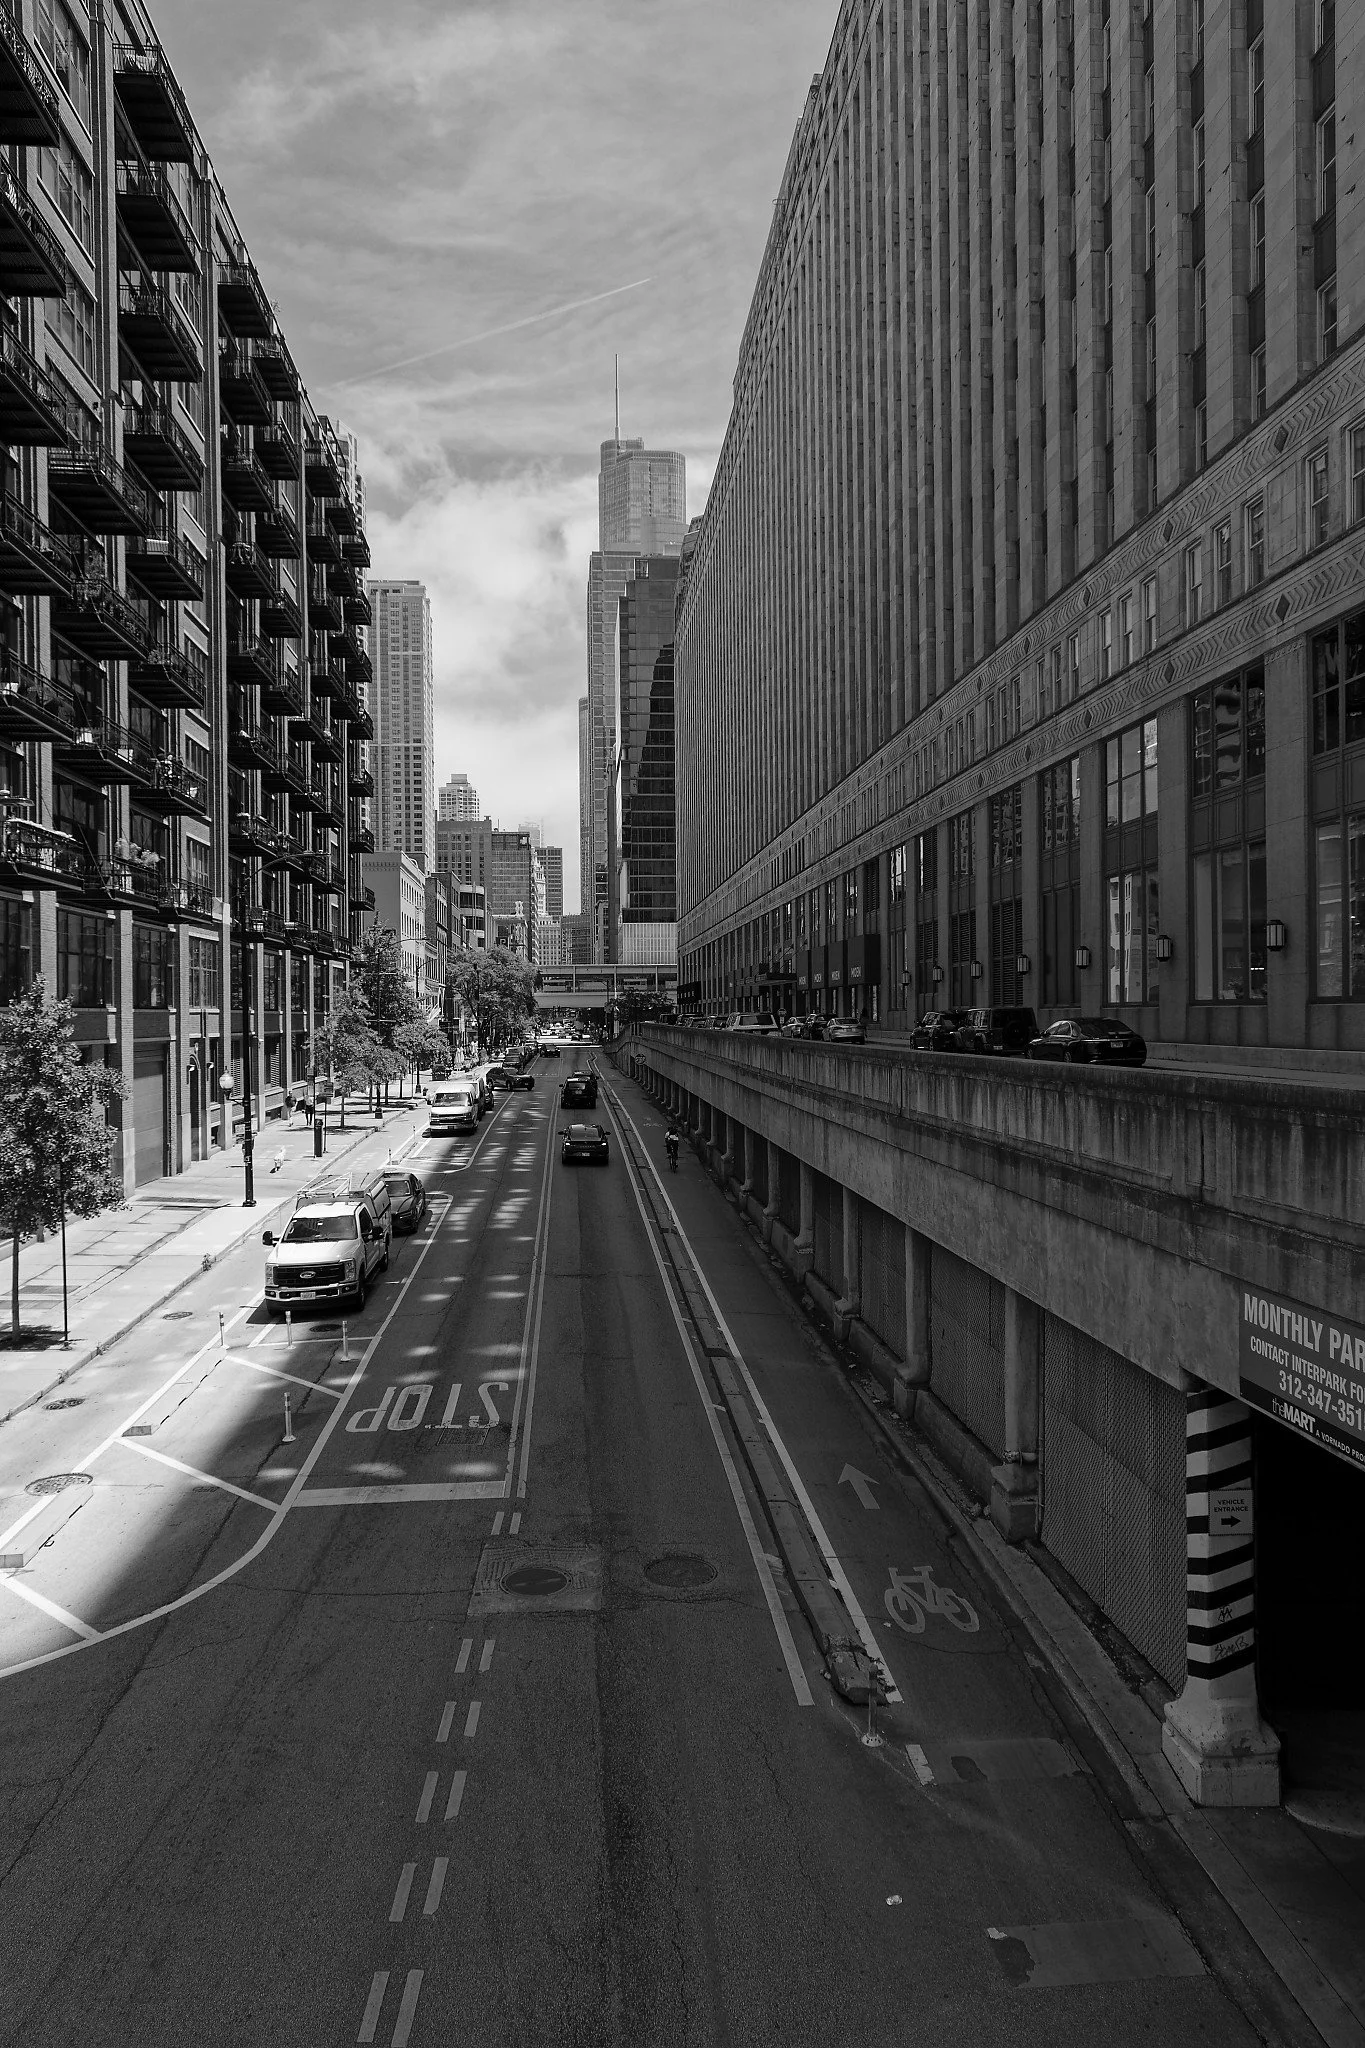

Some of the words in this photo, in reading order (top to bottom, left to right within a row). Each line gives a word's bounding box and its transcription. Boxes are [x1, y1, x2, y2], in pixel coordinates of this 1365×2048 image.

[1244, 1293, 1323, 1352] MONTHLY
[1329, 1327, 1365, 1373] PAR
[1250, 1335, 1290, 1366] CONTACT
[1292, 1357, 1348, 1396] INTERPARK
[1350, 1380, 1365, 1405] FO
[1279, 1370, 1365, 1432] 312-347-351
[345, 1381, 509, 1433] STOP
[1316, 1429, 1321, 1438] A
[1322, 1434, 1351, 1454] VORNADO
[1352, 1450, 1365, 1464] PRO
